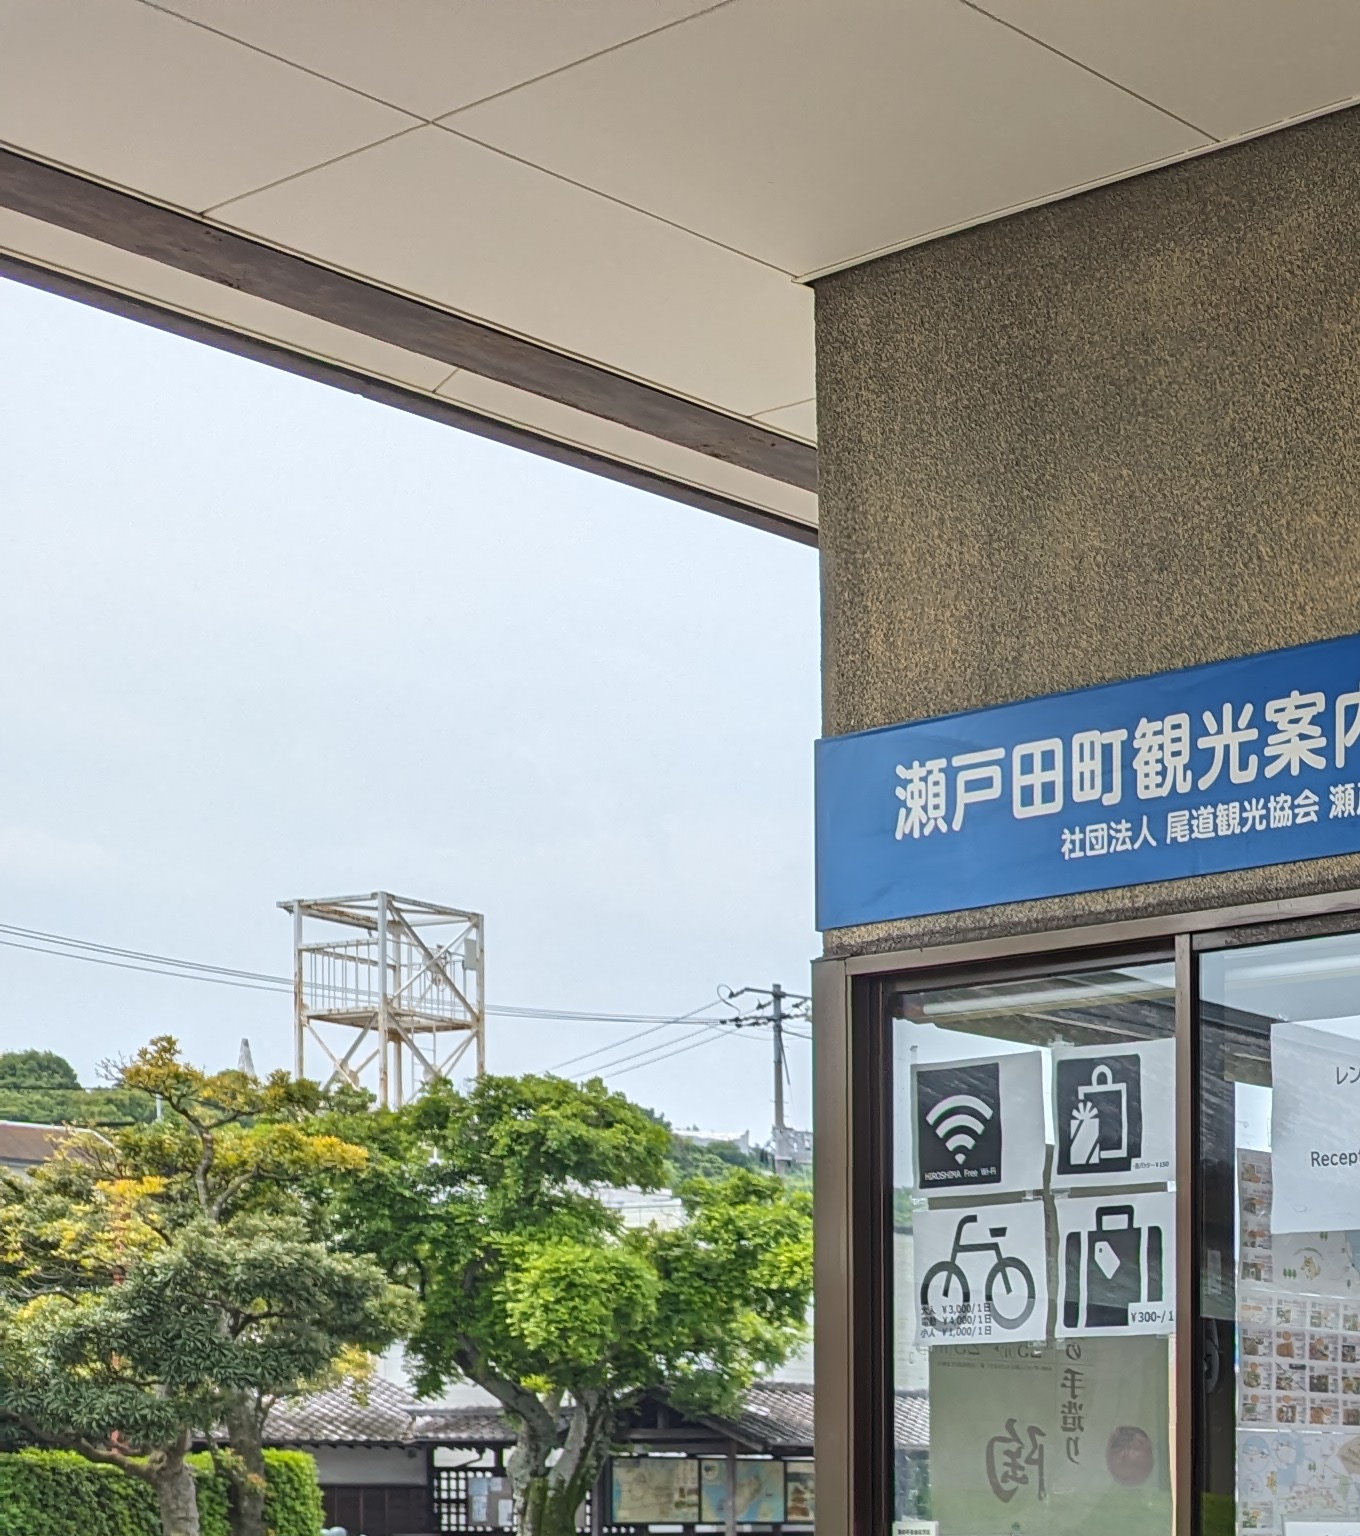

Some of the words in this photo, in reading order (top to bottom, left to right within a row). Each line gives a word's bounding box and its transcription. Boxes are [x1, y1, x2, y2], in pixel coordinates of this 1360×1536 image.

[1060, 817, 1158, 861] 社団法人
[1165, 791, 1320, 847] 尾道観光協会
